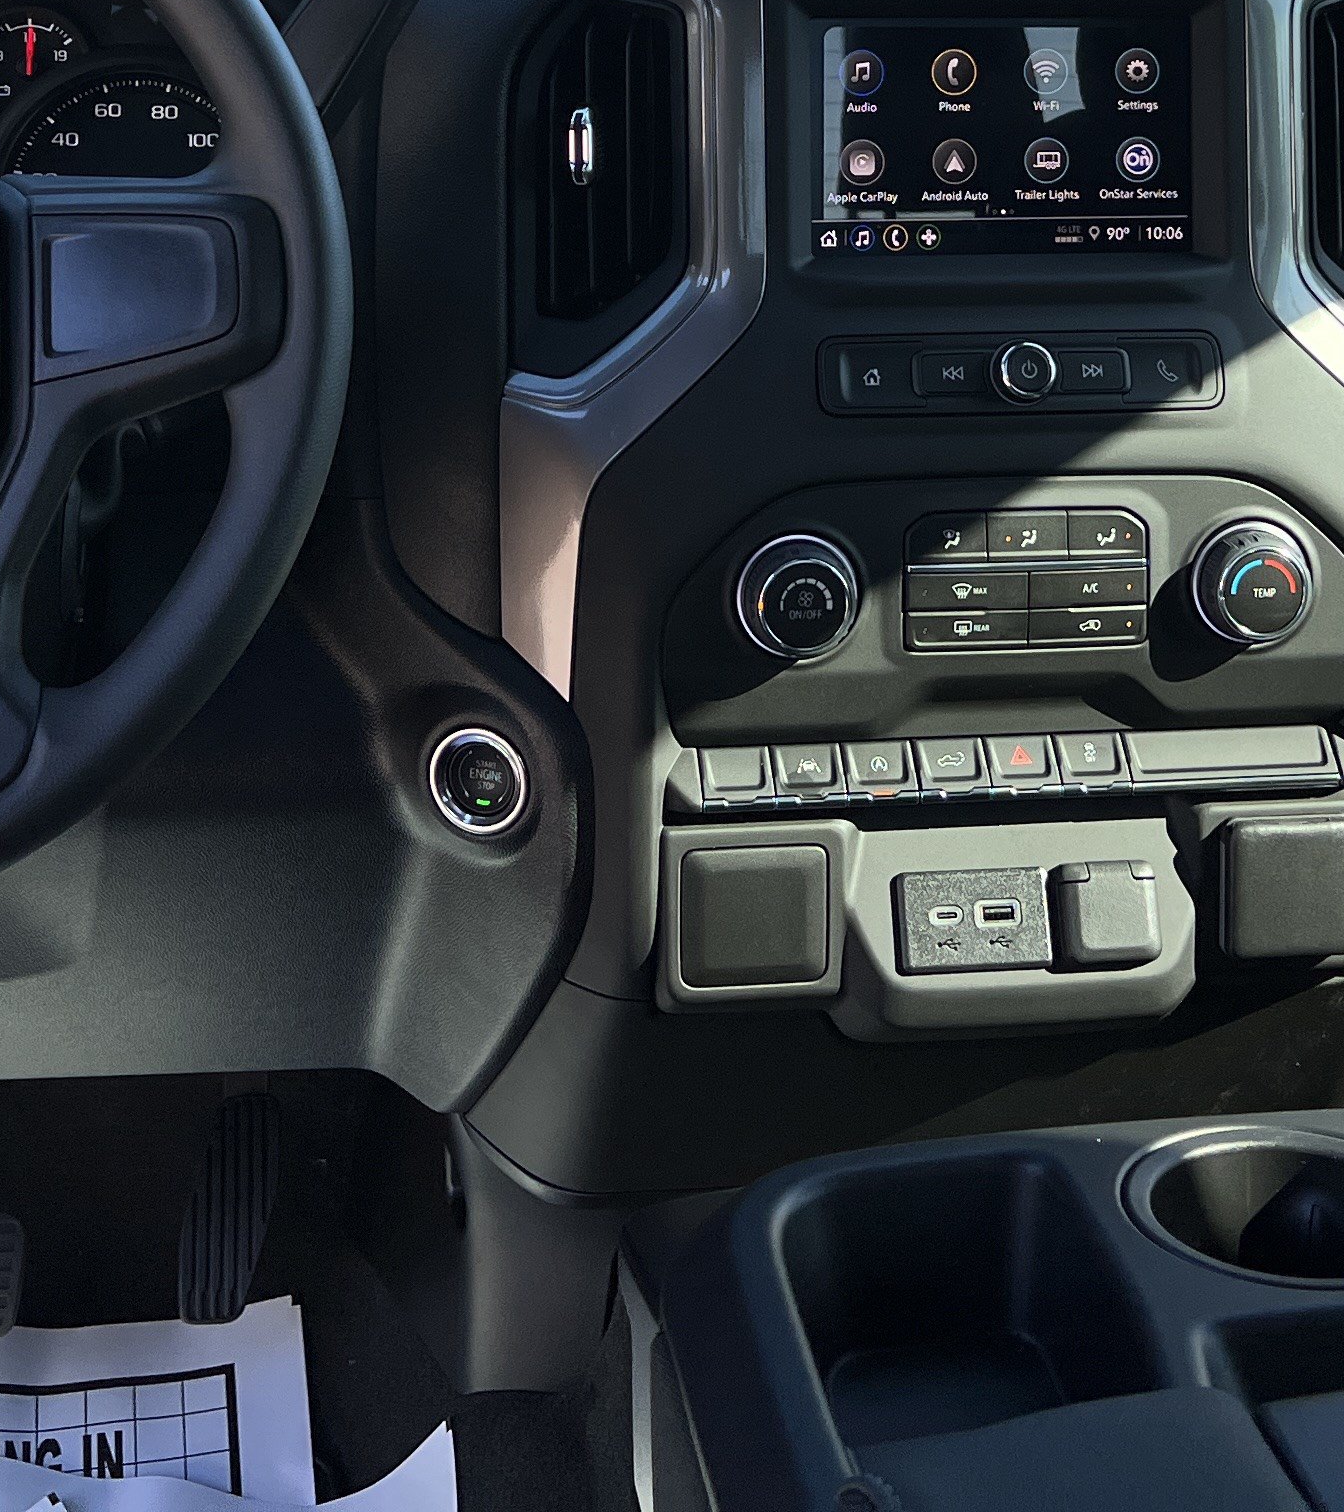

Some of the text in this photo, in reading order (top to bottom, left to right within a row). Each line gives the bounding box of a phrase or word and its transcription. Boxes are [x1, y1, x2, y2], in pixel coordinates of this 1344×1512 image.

[54, 50, 68, 62] 19
[94, 103, 122, 118] 60
[151, 105, 179, 120] 80
[846, 101, 878, 114] Audio
[938, 101, 971, 113] Phone
[1033, 100, 1060, 112] Wi-Fi
[1117, 100, 1159, 114] Settings
[51, 132, 79, 148] 40
[187, 133, 220, 148] 100
[827, 191, 899, 205] Apple CarPlay
[922, 190, 989, 202] Android Auto
[1015, 189, 1080, 202] Trailer Lights
[1099, 188, 1179, 200] OnStar Services
[1145, 226, 1184, 241] 10:06
[972, 587, 988, 595] MAX
[1082, 583, 1099, 594] A/C
[1253, 588, 1277, 599] TEMP
[788, 610, 824, 621] ON/OFF
[469, 768, 503, 783] ENGINE
[477, 782, 496, 791] STOP
[83, 1431, 124, 1479] IN
